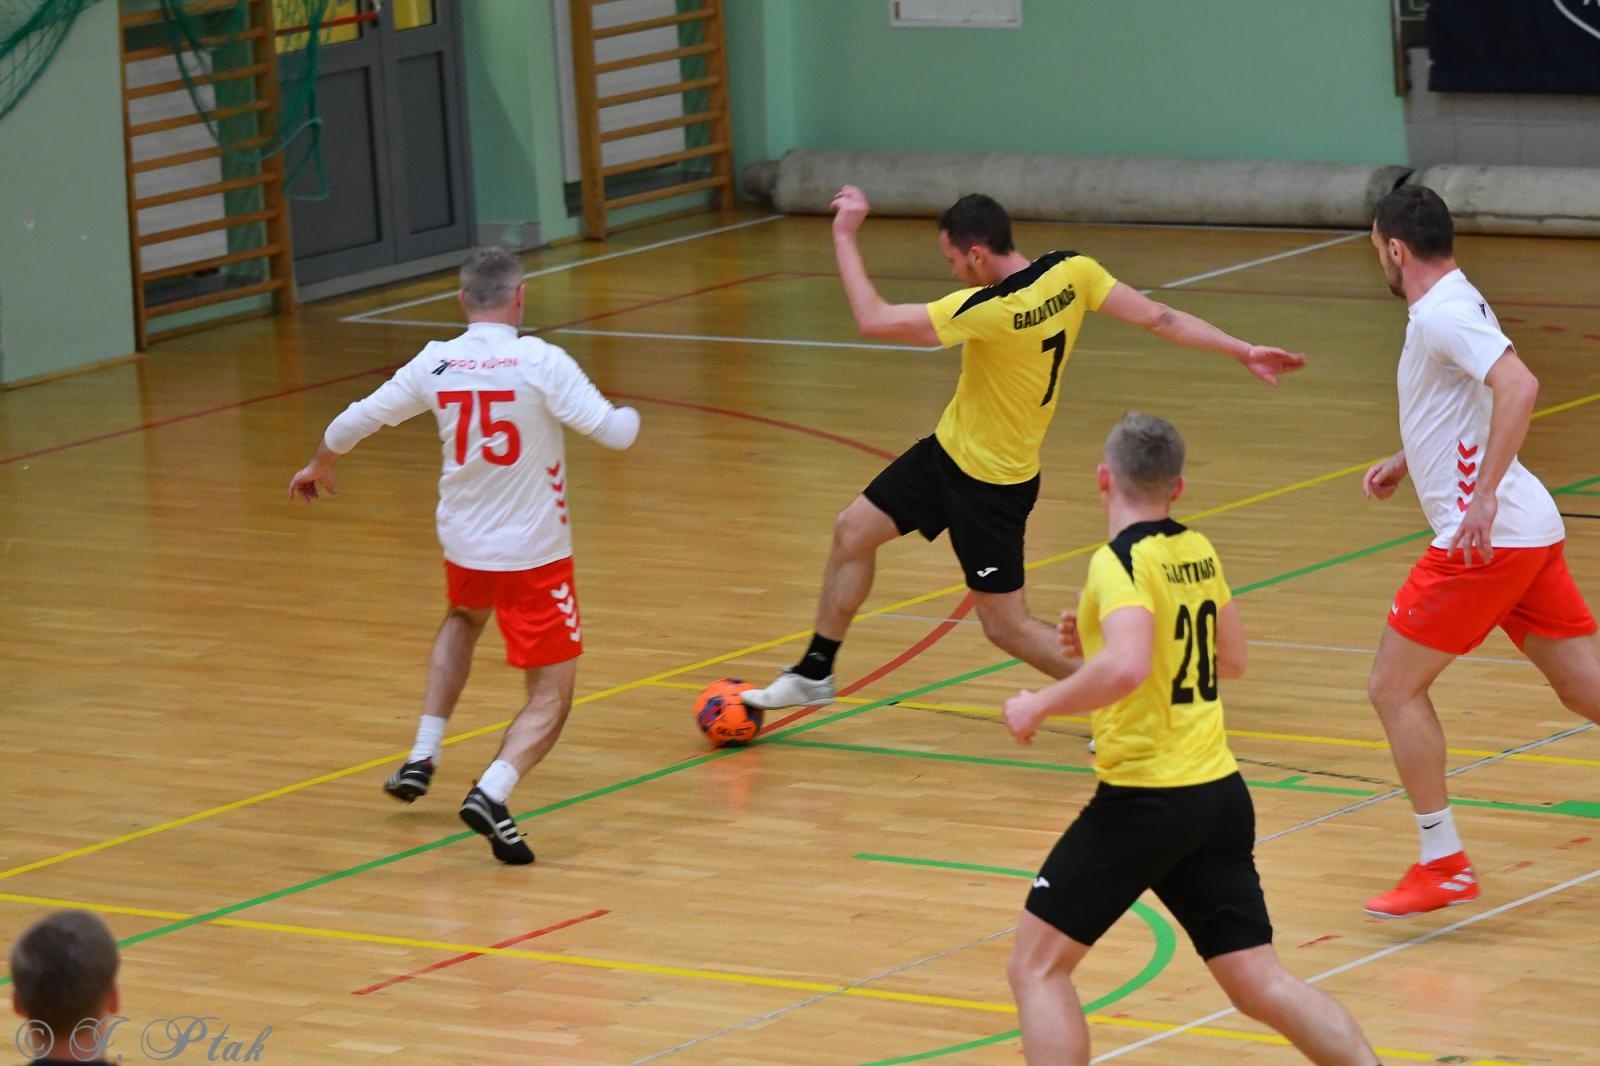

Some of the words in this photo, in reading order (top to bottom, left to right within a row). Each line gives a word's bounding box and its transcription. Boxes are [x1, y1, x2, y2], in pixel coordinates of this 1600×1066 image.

[1041, 328, 1066, 407] 7
[437, 390, 522, 466] 75
[1171, 599, 1217, 705] 20
